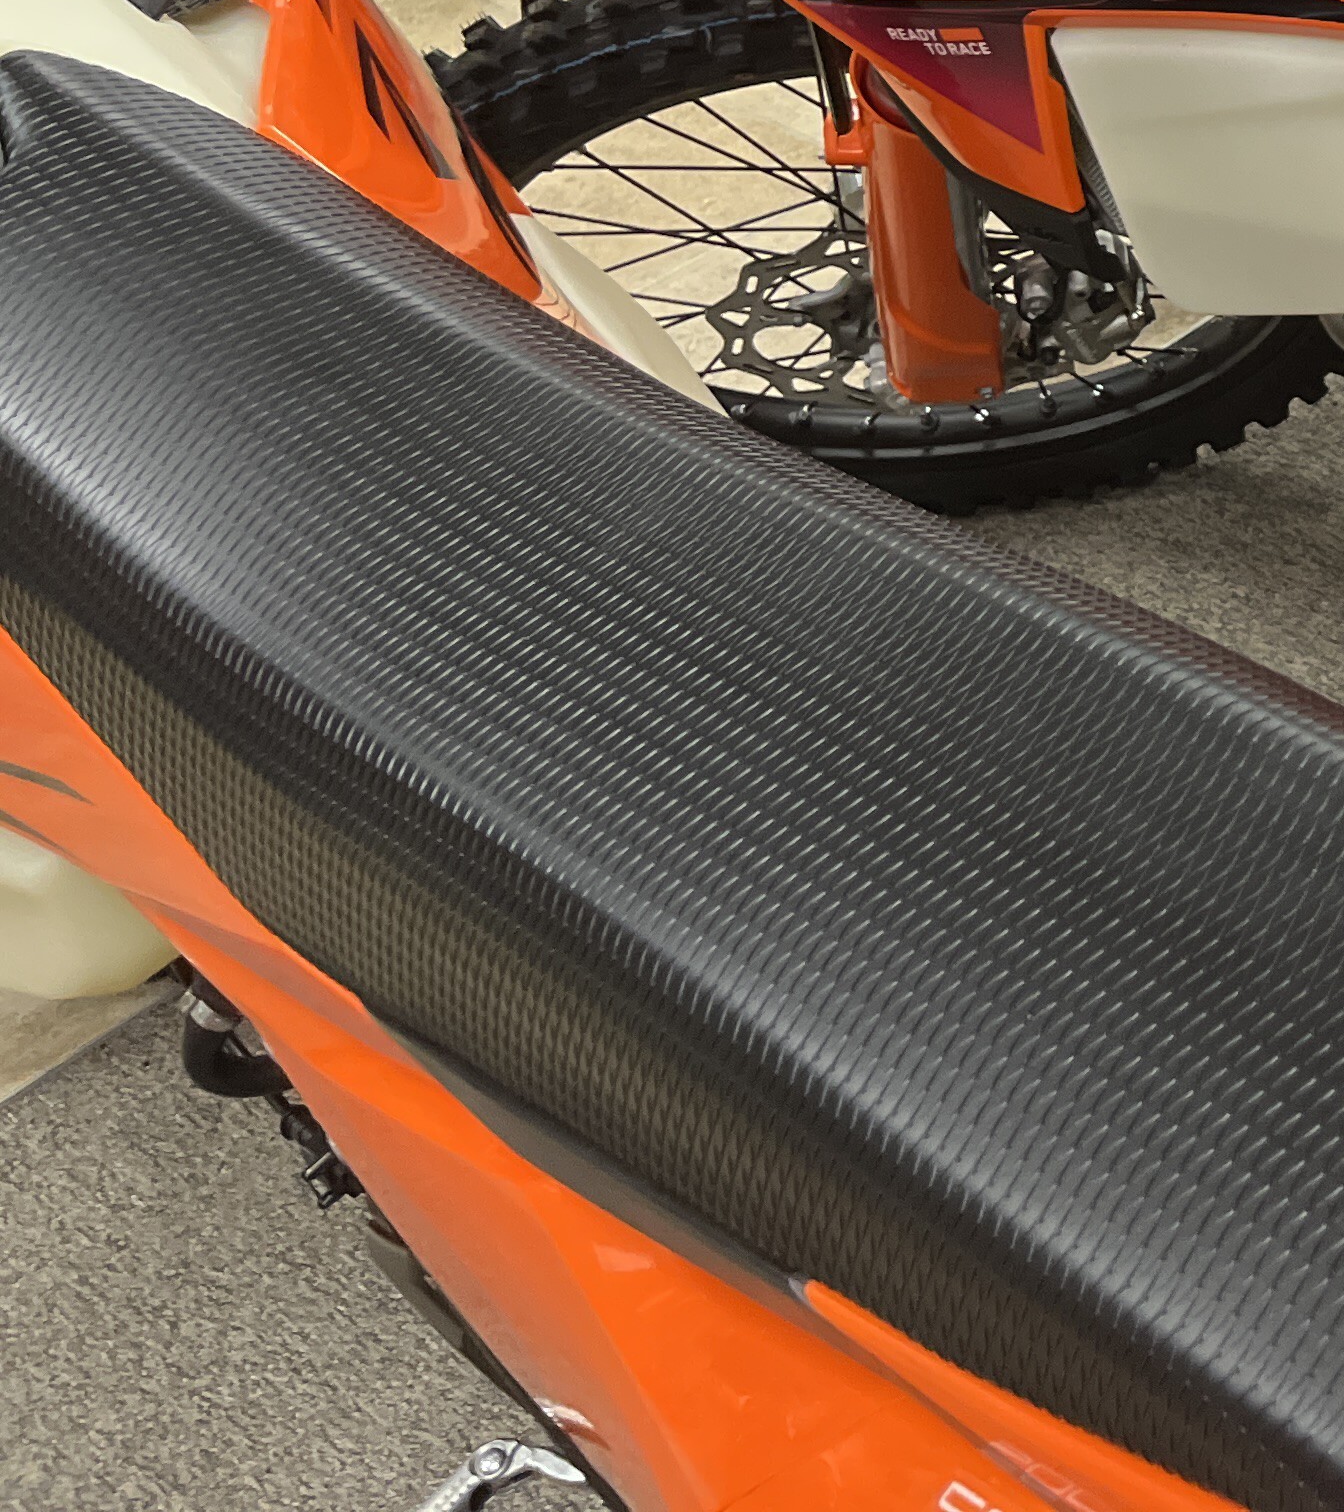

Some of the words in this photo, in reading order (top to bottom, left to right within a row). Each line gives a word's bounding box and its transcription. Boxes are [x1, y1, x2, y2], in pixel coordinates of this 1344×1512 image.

[886, 27, 938, 42] READY
[923, 42, 947, 56] TO
[946, 41, 992, 56] RACE
